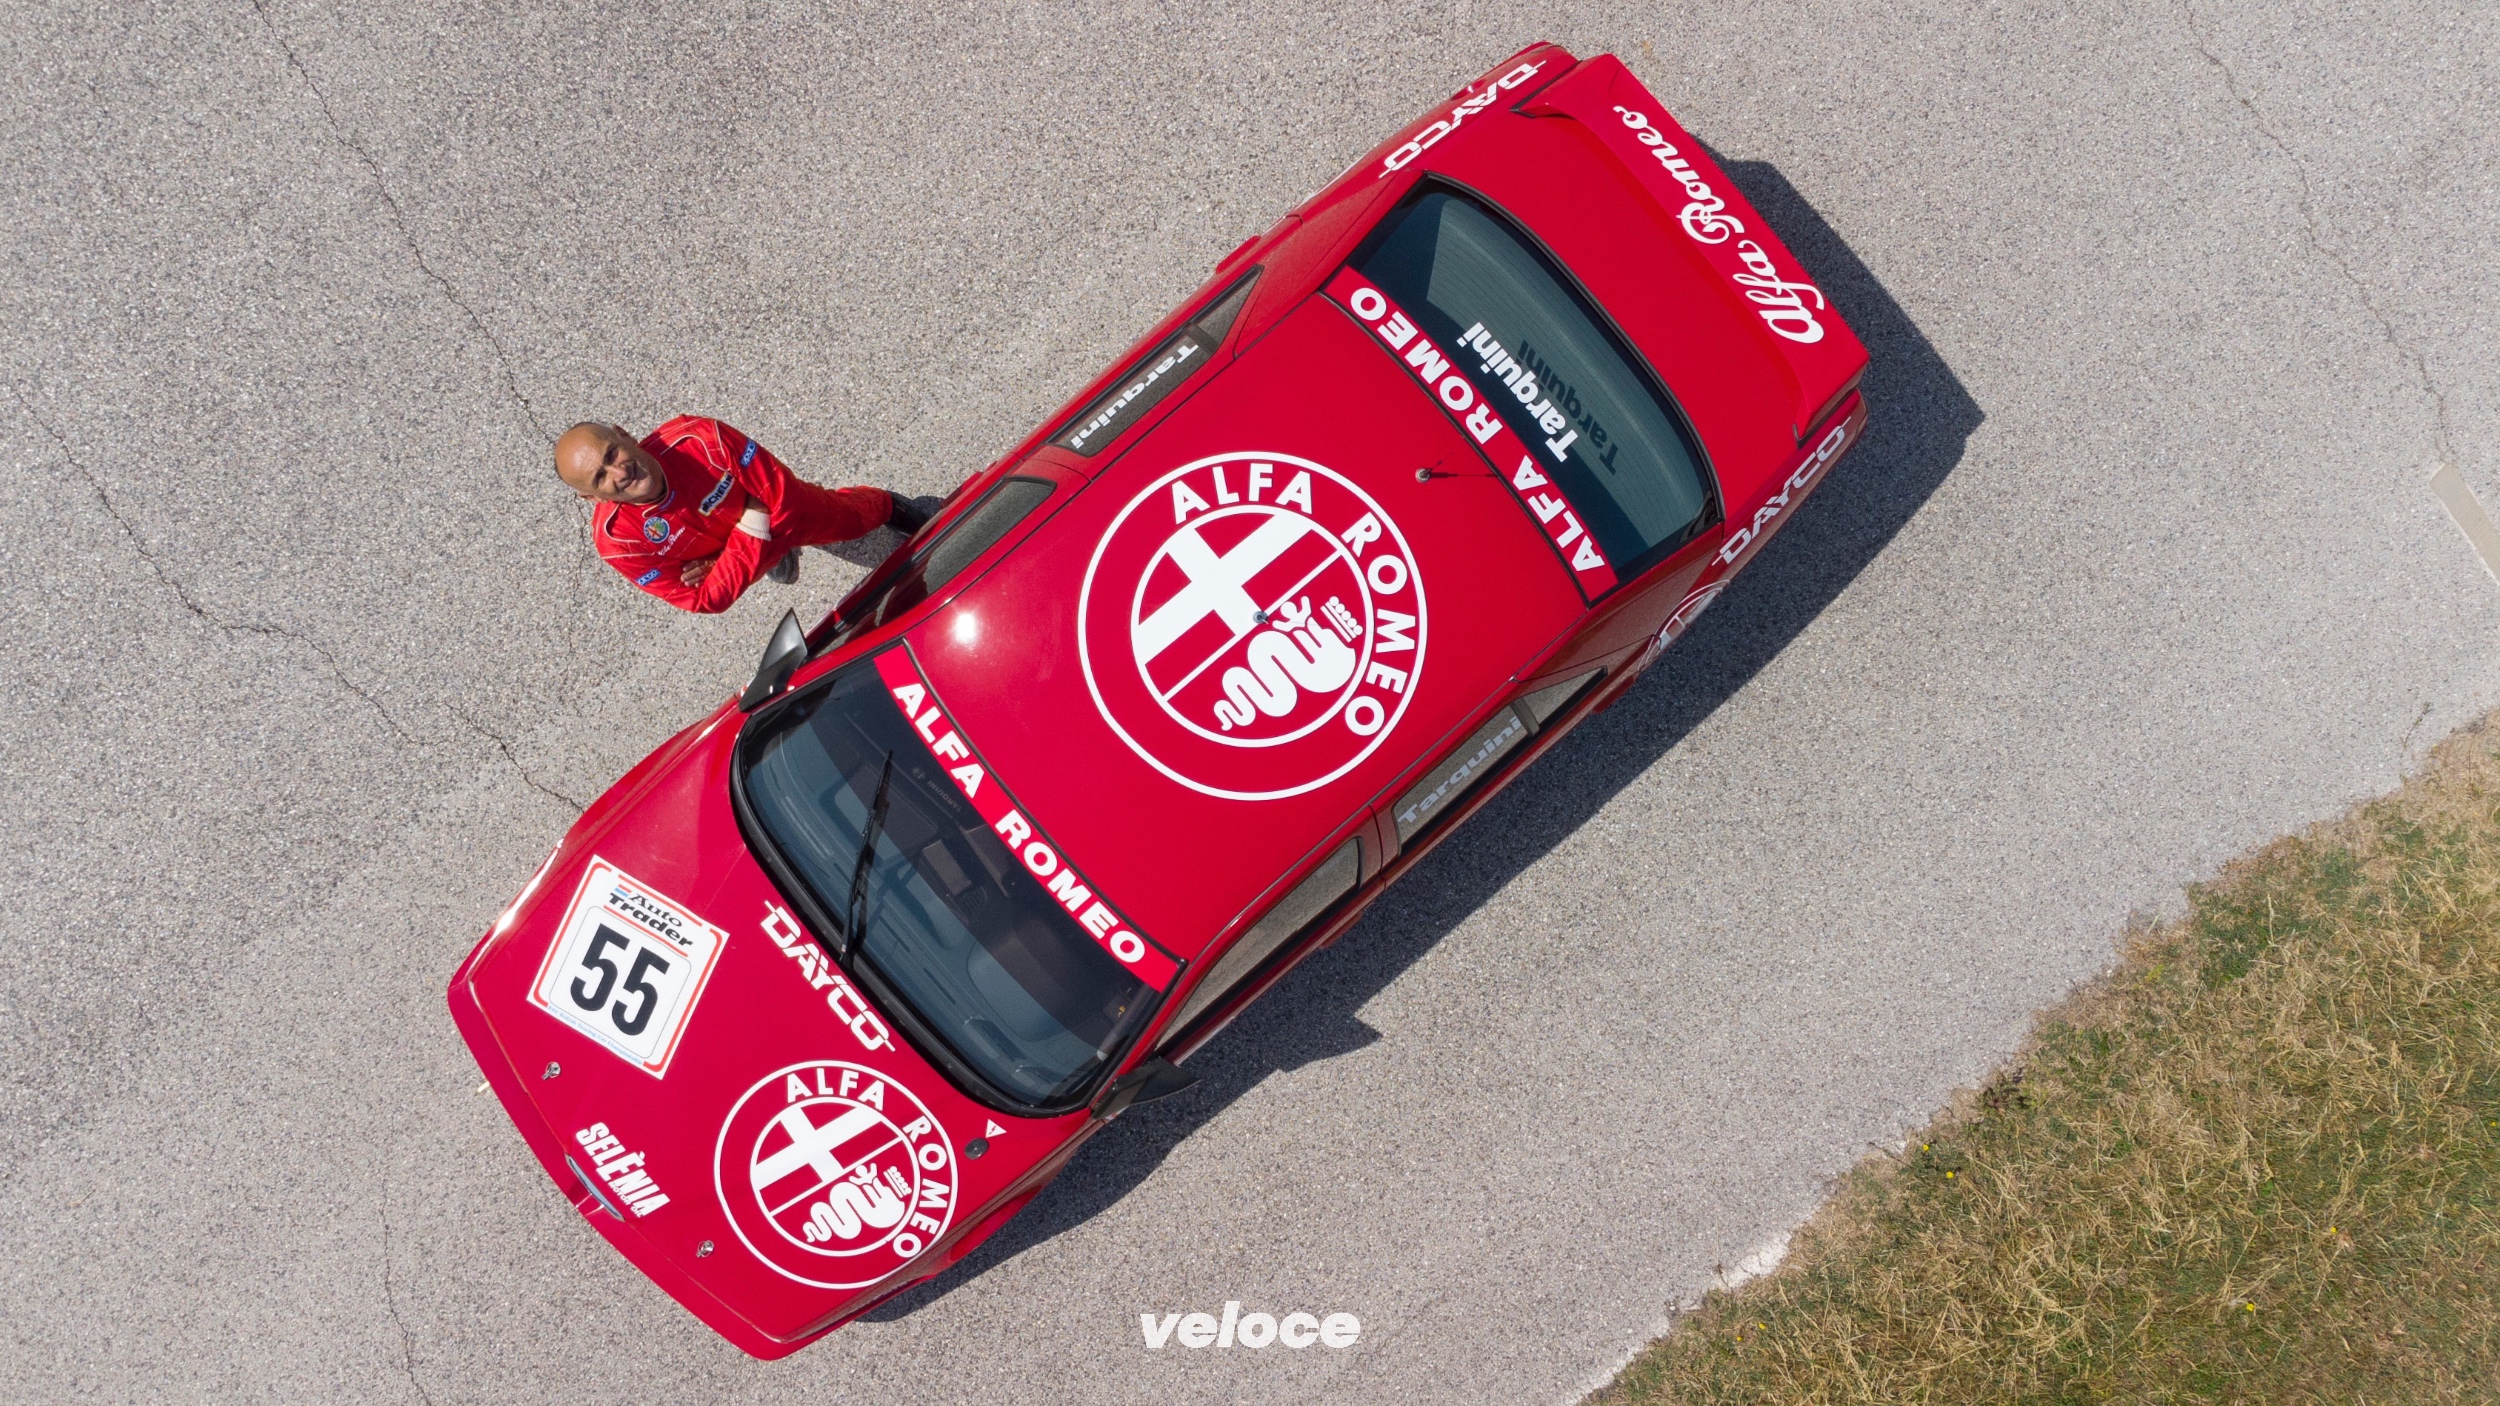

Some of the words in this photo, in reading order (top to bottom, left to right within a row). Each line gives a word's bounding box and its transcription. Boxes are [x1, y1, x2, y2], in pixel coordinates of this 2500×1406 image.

[1378, 60, 1547, 178] DAYCO
[1612, 105, 1745, 244] Romeo
[1070, 344, 1199, 450] Tarquini
[1350, 286, 1503, 445] ROMEO
[1455, 321, 1579, 463] Tarquini
[701, 473, 733, 513] MICHELIN
[1512, 454, 1606, 572] ALFA
[1711, 415, 1852, 567] DAYCO
[1171, 462, 1313, 525] ALFA
[1340, 511, 1417, 736] ROMEO
[892, 682, 985, 799] ALFA
[994, 809, 1146, 963] ROMEO
[1397, 715, 1522, 824] Tarquini
[608, 892, 694, 946] Trader
[628, 893, 683, 928] Auto
[569, 922, 671, 1036] 55
[759, 899, 896, 1052] DAYCO
[787, 1067, 885, 1111] ALFA
[893, 1114, 950, 1259] ROMEO
